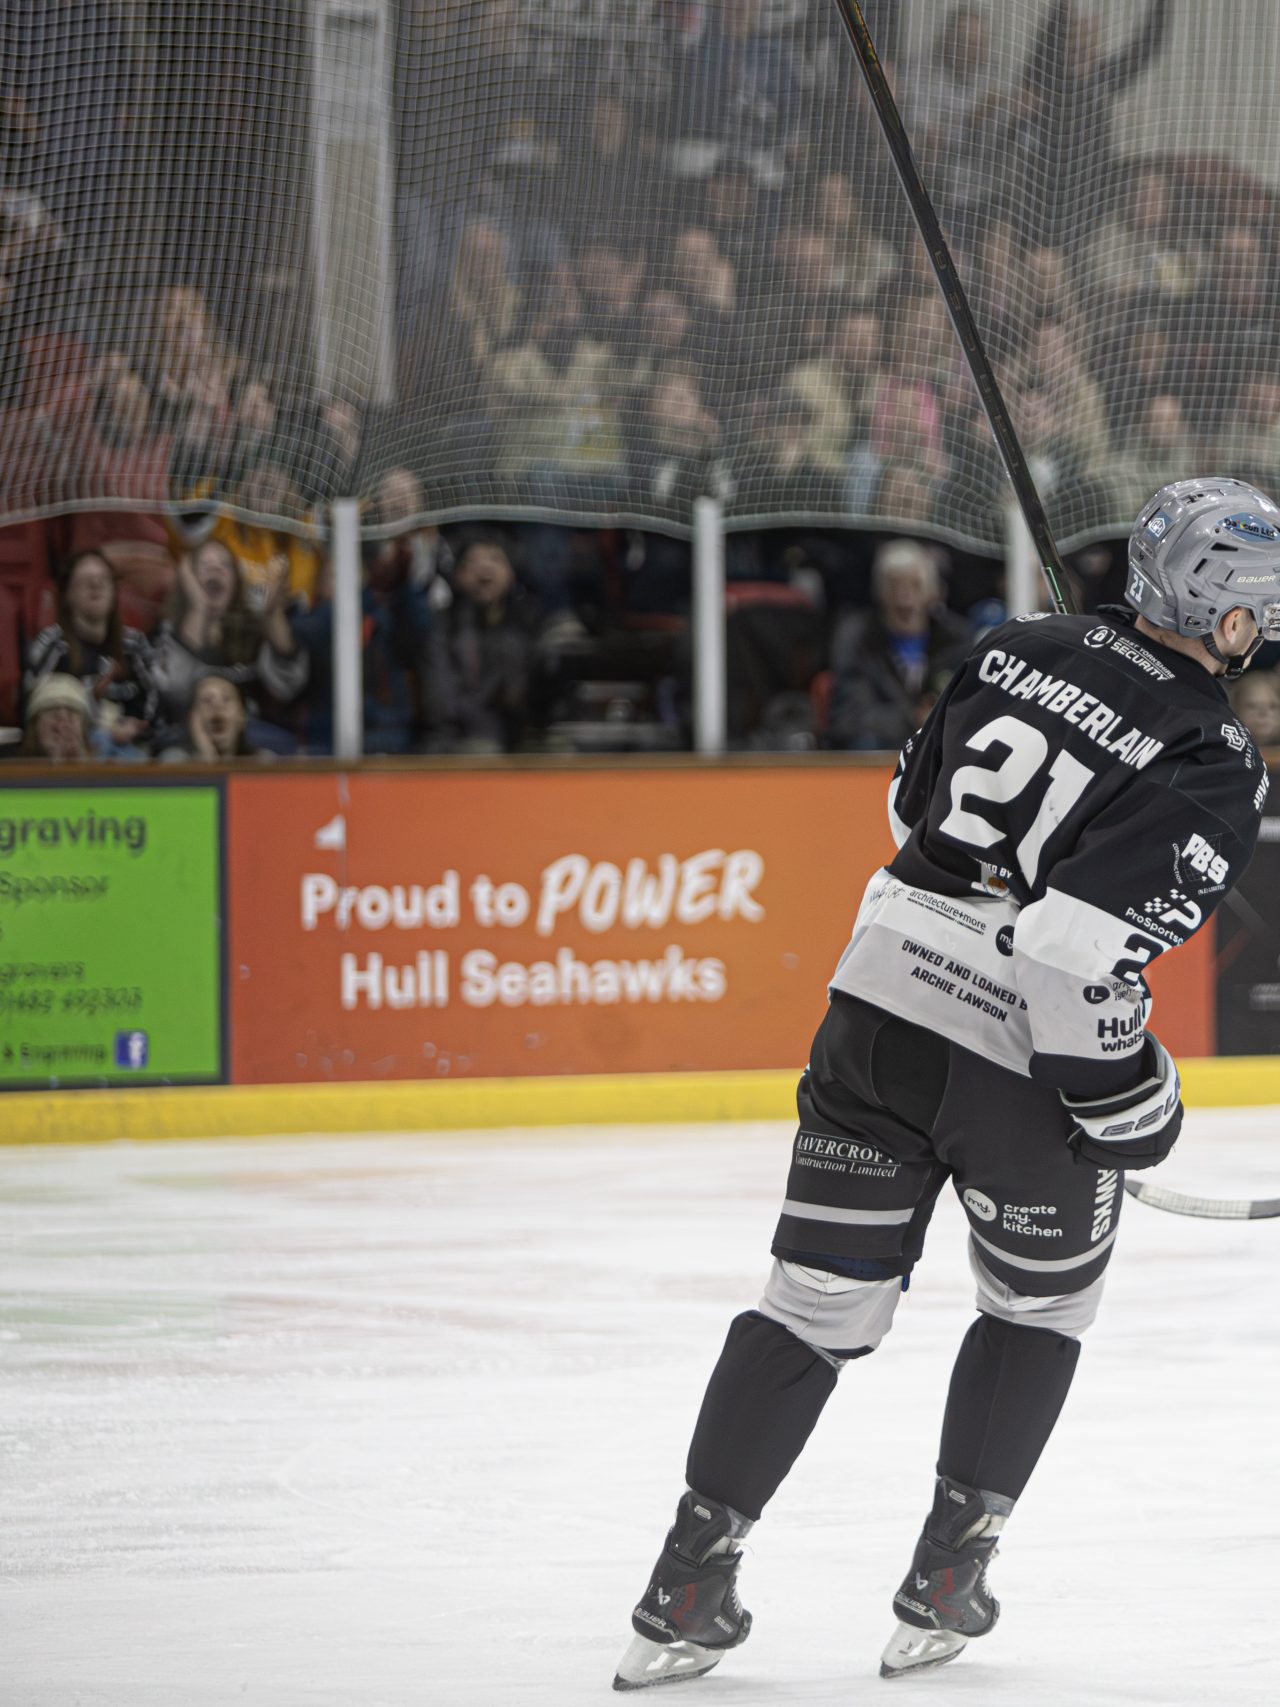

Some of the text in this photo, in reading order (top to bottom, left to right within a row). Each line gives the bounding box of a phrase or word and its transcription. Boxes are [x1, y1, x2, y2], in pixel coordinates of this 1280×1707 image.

[1129, 575, 1145, 603] 21
[1110, 641, 1168, 681] SECURITY
[978, 649, 1165, 771] CHAMBERLAIN
[939, 715, 1096, 890] 21
[0, 808, 147, 857] graving
[1181, 833, 1229, 884] PBS
[301, 848, 766, 936] Proud to POWER
[340, 944, 727, 1010] Hull Seahawks
[901, 939, 945, 968] OWNED
[944, 961, 972, 981] AND
[972, 973, 1018, 1006] LOANED
[910, 966, 1009, 1022] ARCHIE LAWSON
[849, 1161, 897, 1178] Limited
[1002, 1219, 1063, 1237] kitchen
[1003, 1204, 1057, 1215] create
